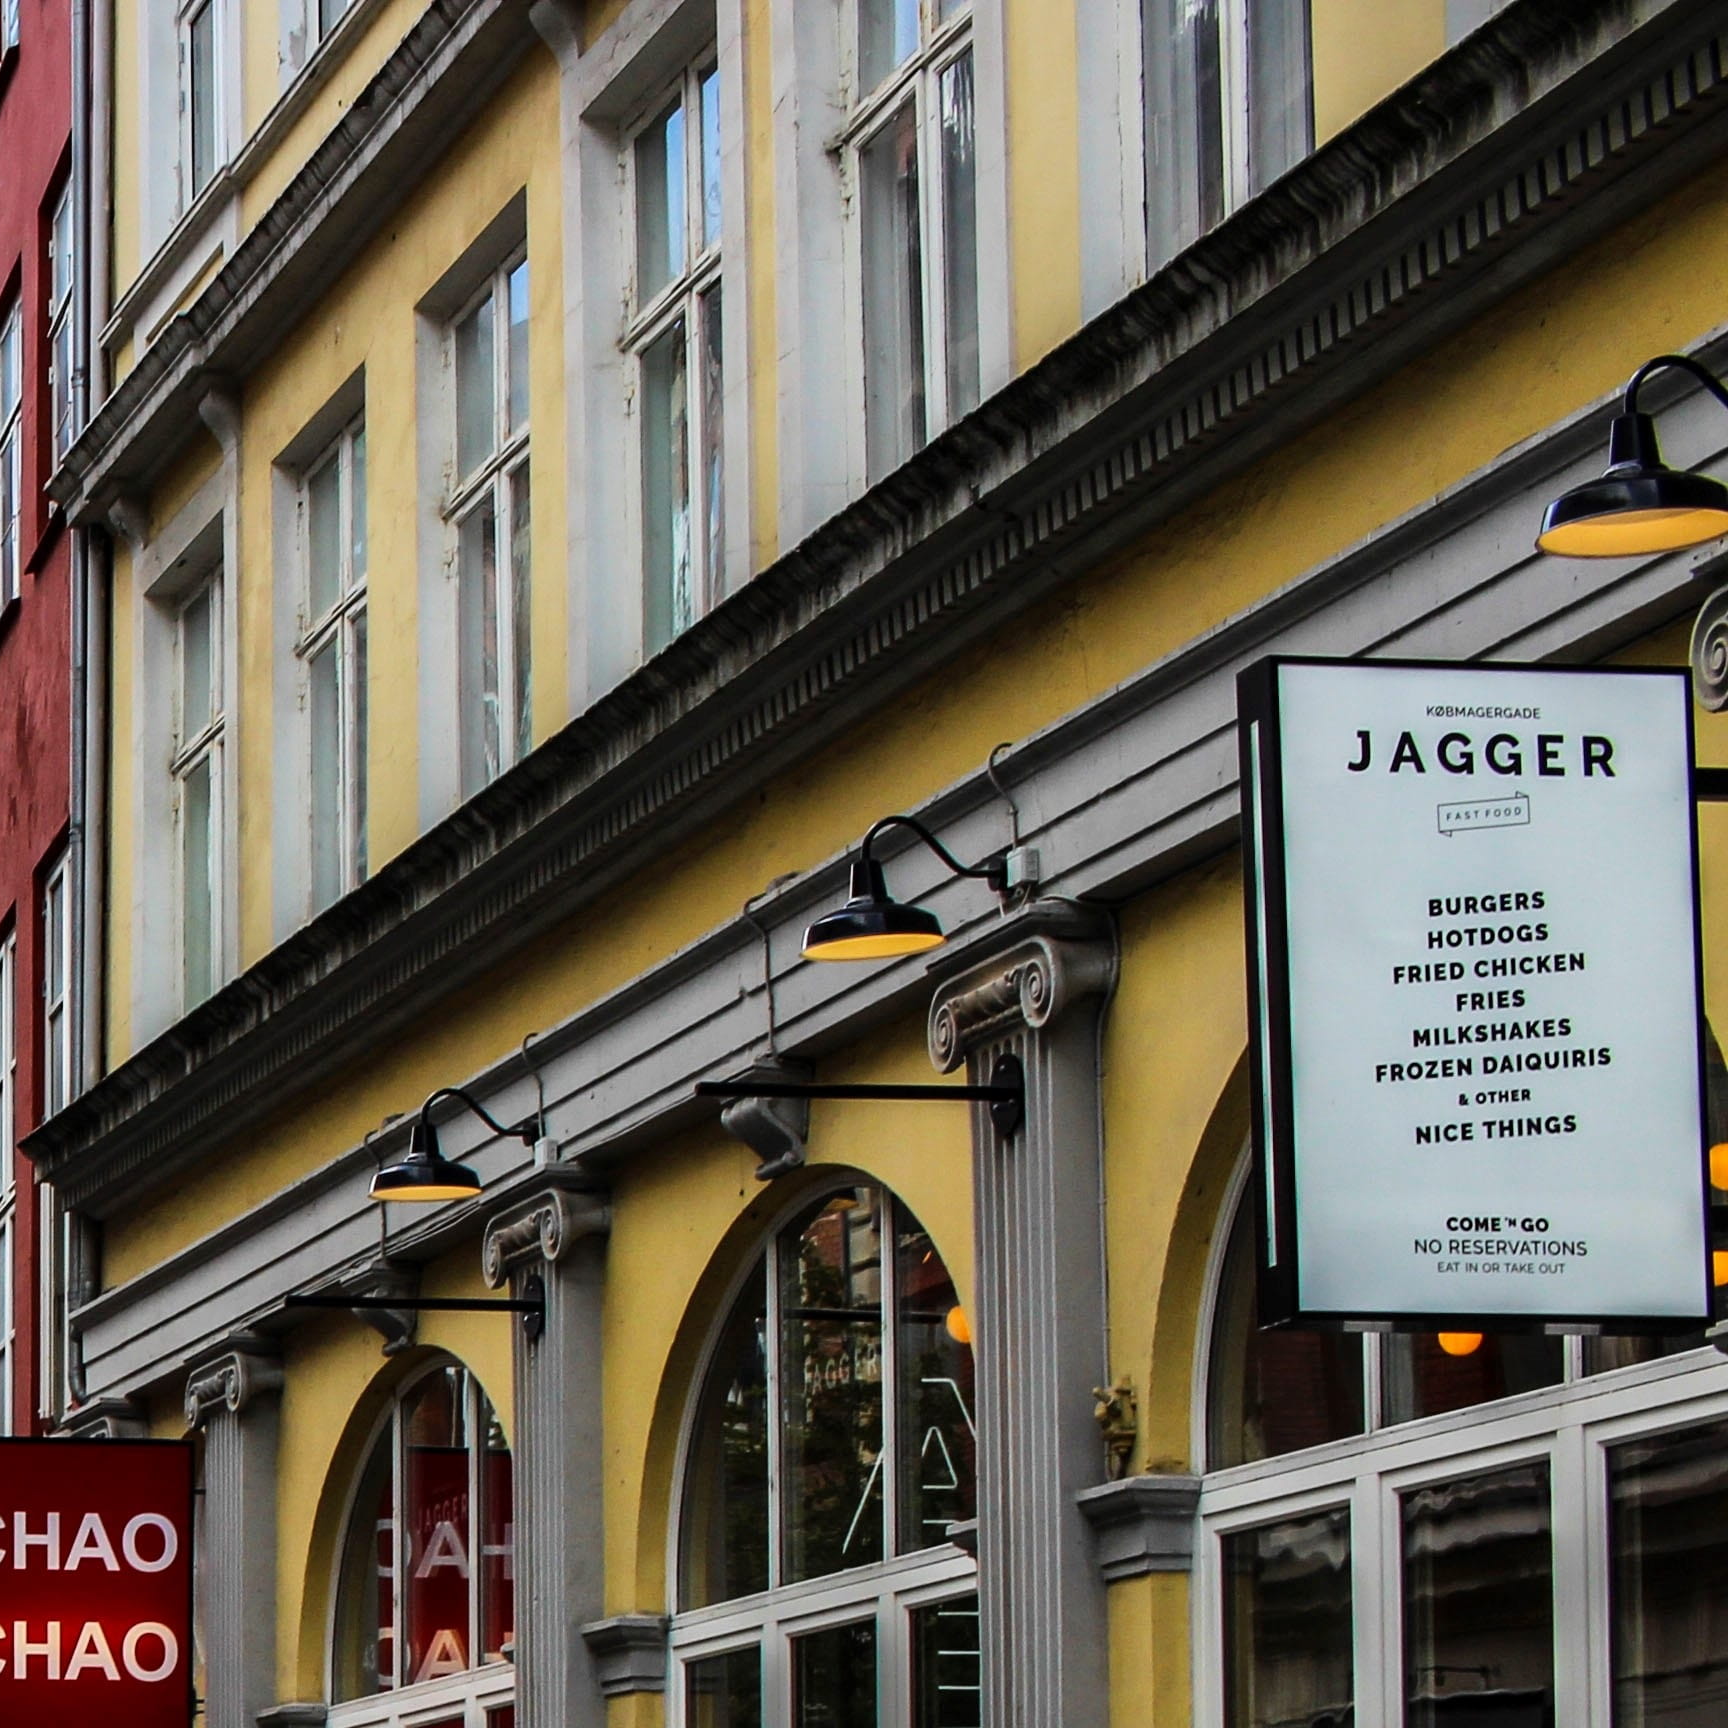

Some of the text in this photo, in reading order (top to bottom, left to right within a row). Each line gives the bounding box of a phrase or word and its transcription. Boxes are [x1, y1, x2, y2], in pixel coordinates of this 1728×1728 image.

[1426, 704, 1542, 720] KØBMAGERGADE
[1347, 730, 1616, 778] JAGGER
[1445, 805, 1523, 822] FAST FOOD
[1428, 891, 1546, 918] BURGERS
[1427, 922, 1550, 950] HOTDOGS
[1393, 952, 1586, 985] FRIED CHICKEN
[1456, 989, 1526, 1012] FRIES
[1412, 1018, 1572, 1048] MILKSHAKES
[1375, 1047, 1612, 1083] FROZEN DAIQUIRIS
[1458, 1088, 1532, 1106] & OTHER
[1415, 1114, 1577, 1145] NICE THINGS
[1446, 1216, 1501, 1232] COME
[1520, 1217, 1550, 1232] GO
[1413, 1238, 1588, 1257] NO RESERVATIONS
[1437, 1261, 1566, 1275] EAT IN OR TAKE OUT
